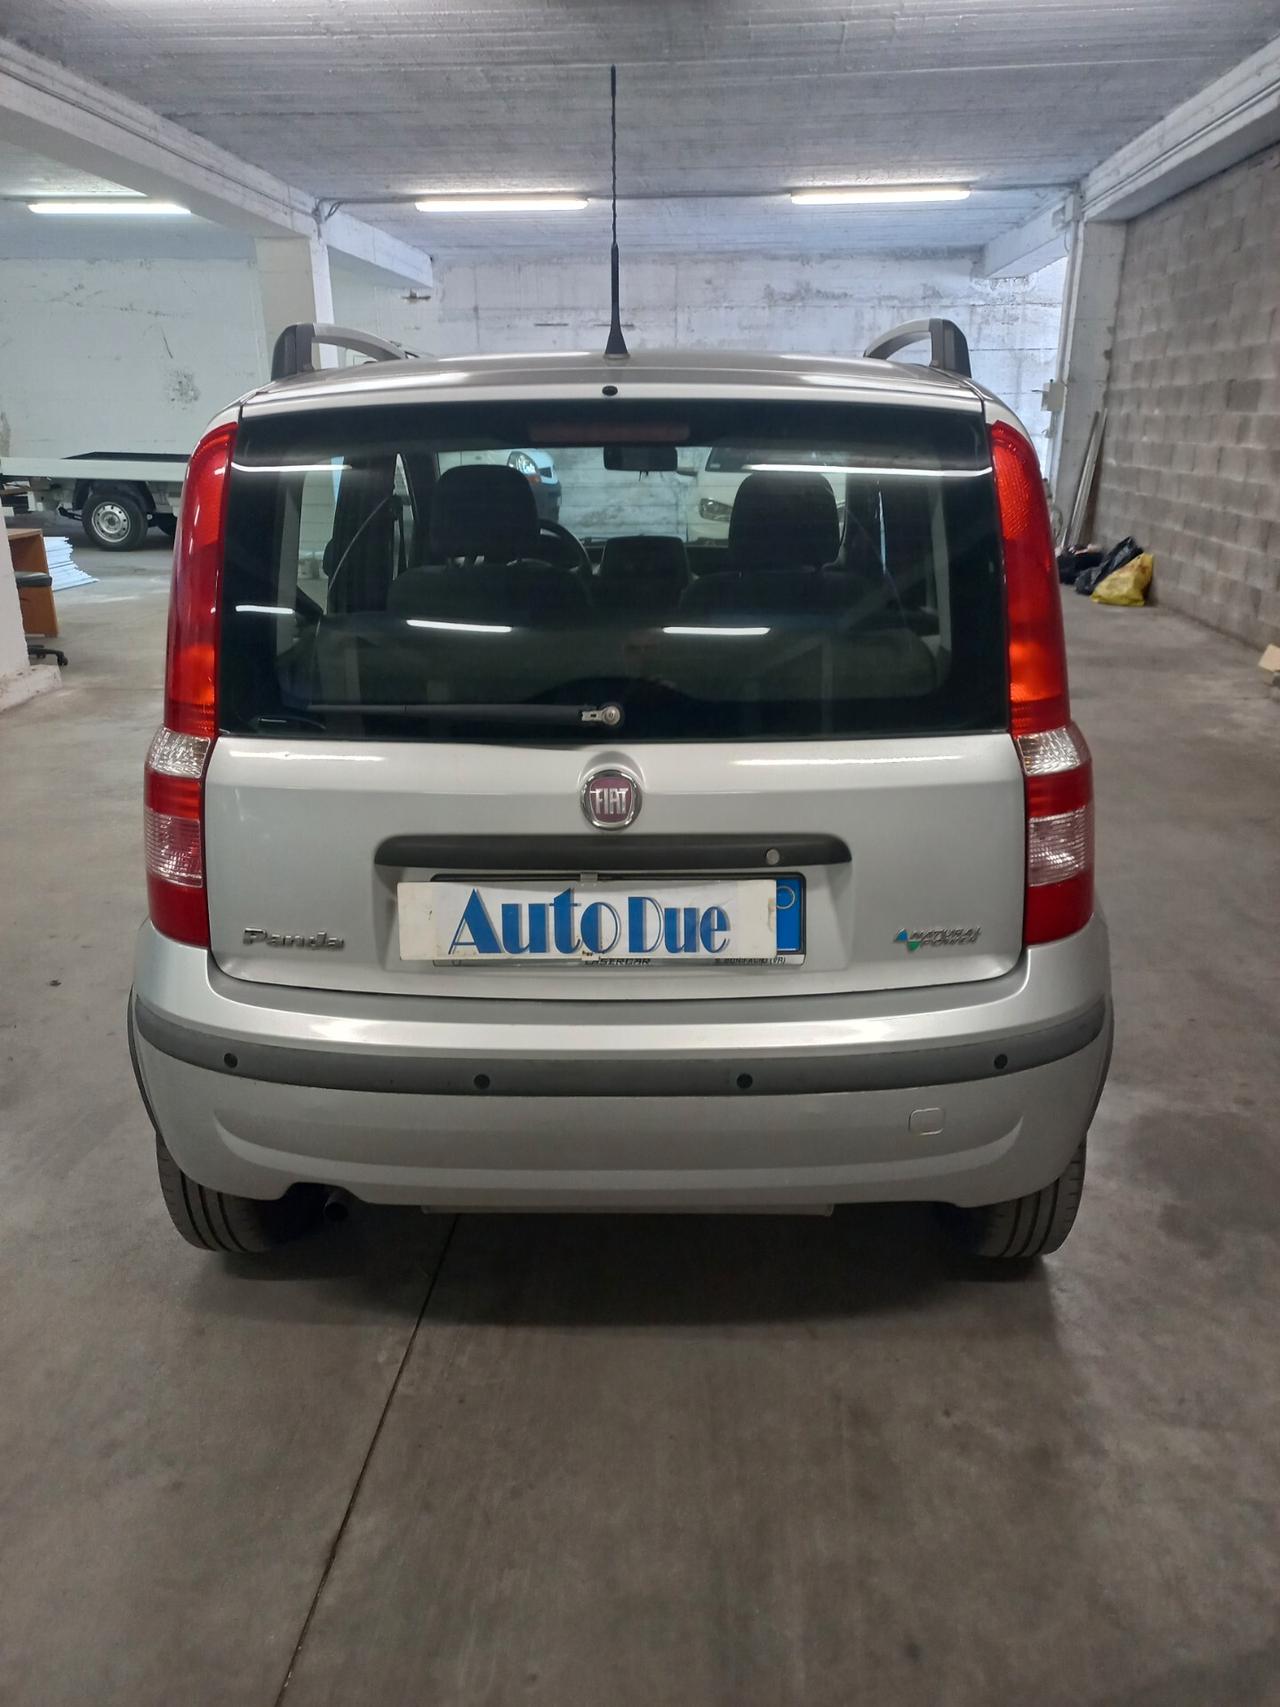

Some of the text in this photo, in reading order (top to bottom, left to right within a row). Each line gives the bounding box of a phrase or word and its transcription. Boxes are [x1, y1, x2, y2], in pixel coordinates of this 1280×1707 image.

[595, 787, 629, 815] FIAT
[243, 927, 345, 951] Panda
[909, 927, 982, 942] NATURAL
